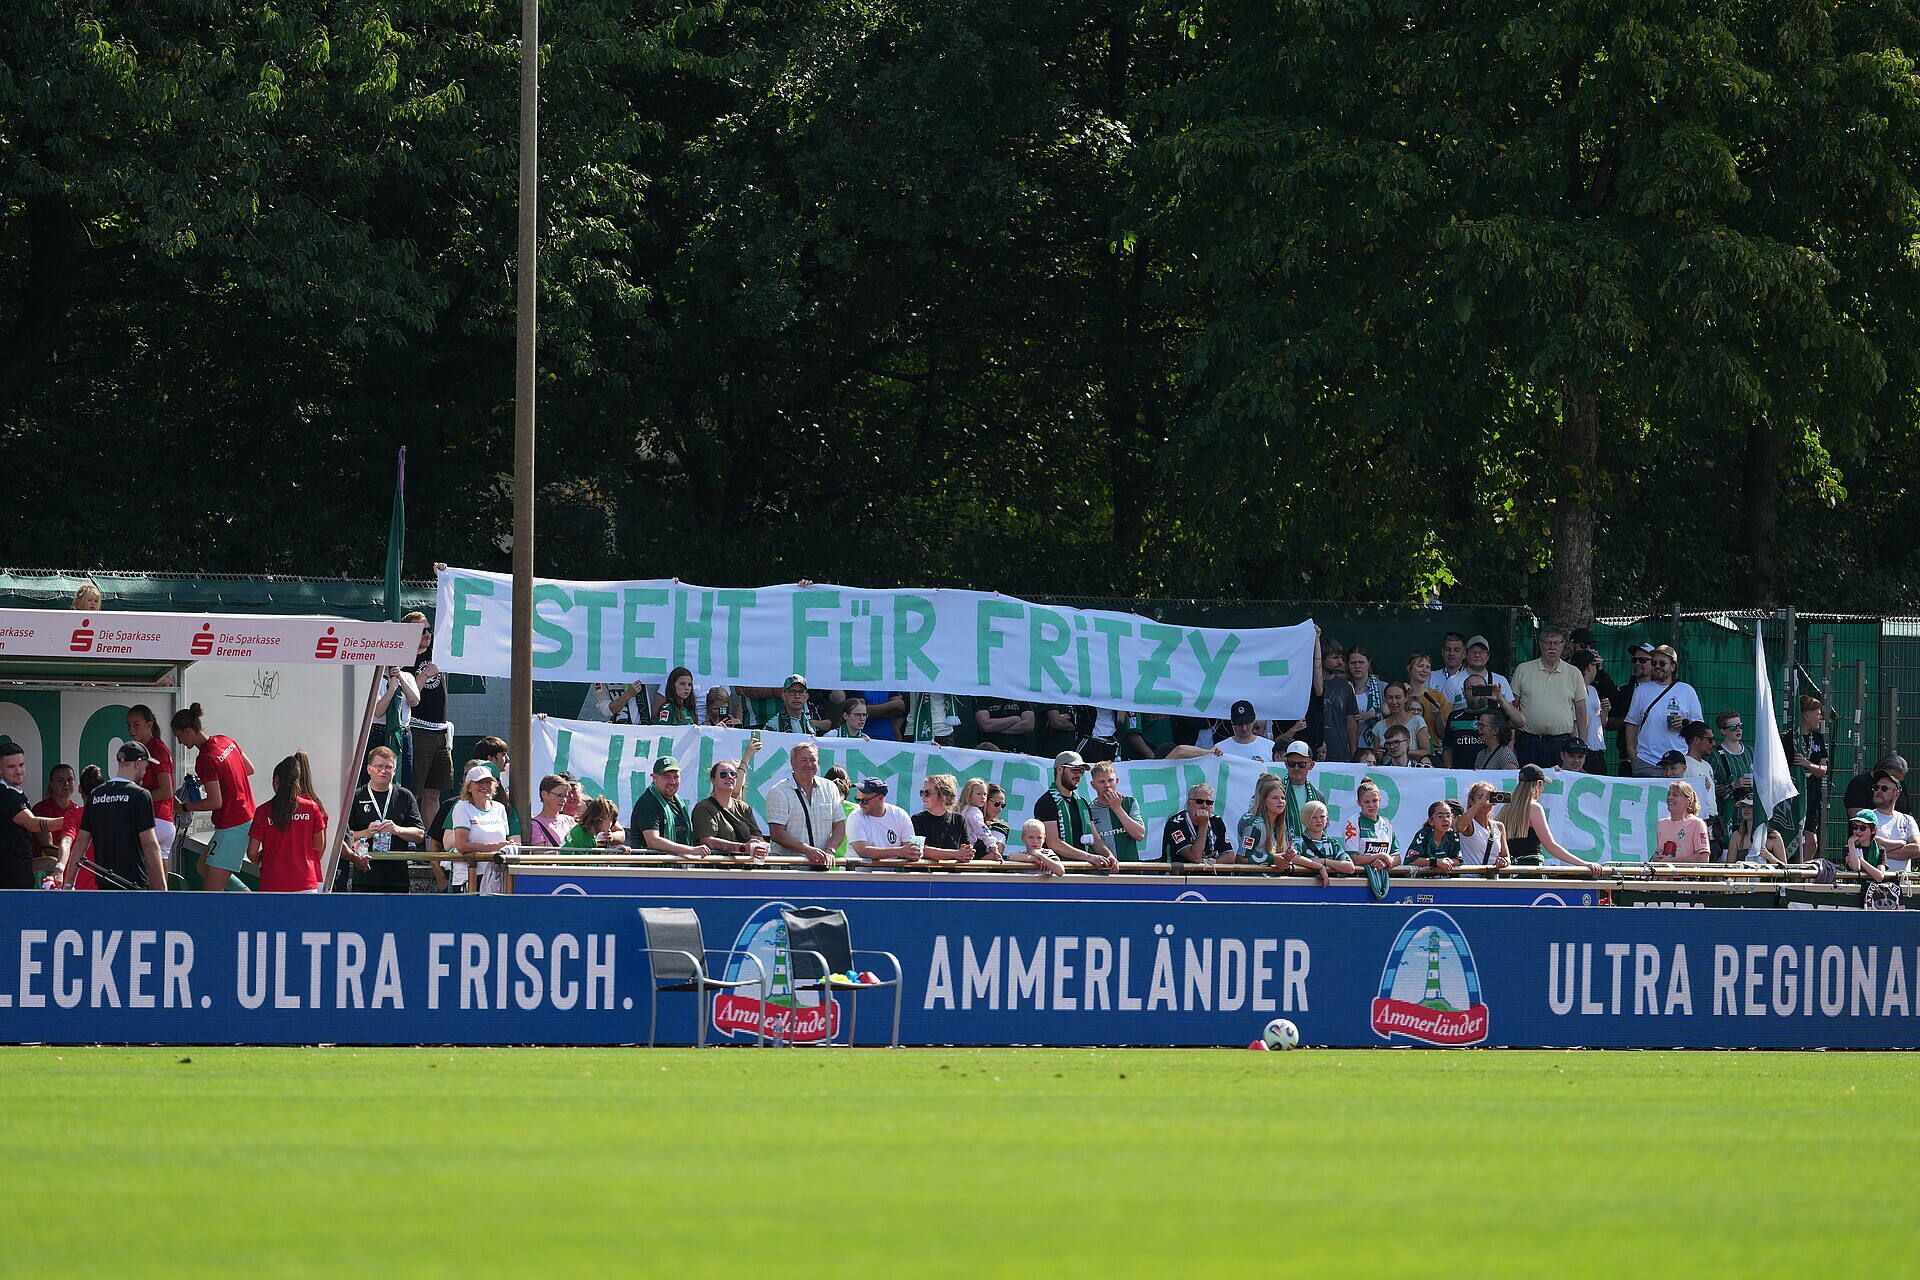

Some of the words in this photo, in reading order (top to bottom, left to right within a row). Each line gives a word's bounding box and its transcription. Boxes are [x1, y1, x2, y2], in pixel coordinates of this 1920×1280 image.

[99, 630, 114, 640] Die
[116, 630, 161, 643] Sparkasse
[449, 577, 495, 658] F
[532, 583, 757, 679] STEHT
[791, 589, 941, 686] FÜR
[219, 633, 235, 644] Die
[236, 634, 281, 647] Sparkasse
[344, 637, 359, 648] Die
[360, 638, 404, 650] Sparkasse
[96, 643, 132, 654] Bremen
[216, 647, 252, 657] Bremen
[340, 651, 376, 661] Bremen
[1456, 735, 1485, 746] citiba
[92, 793, 130, 805] badenova
[237, 931, 405, 1010] ULTRA
[428, 932, 634, 1011] FRISCH.
[923, 923, 1311, 1012] AMMERLÄNDER
[1549, 942, 1694, 1016] ULTRA
[1713, 943, 1920, 1017] REGIONA
[1376, 1004, 1483, 1037] Ammerländer
